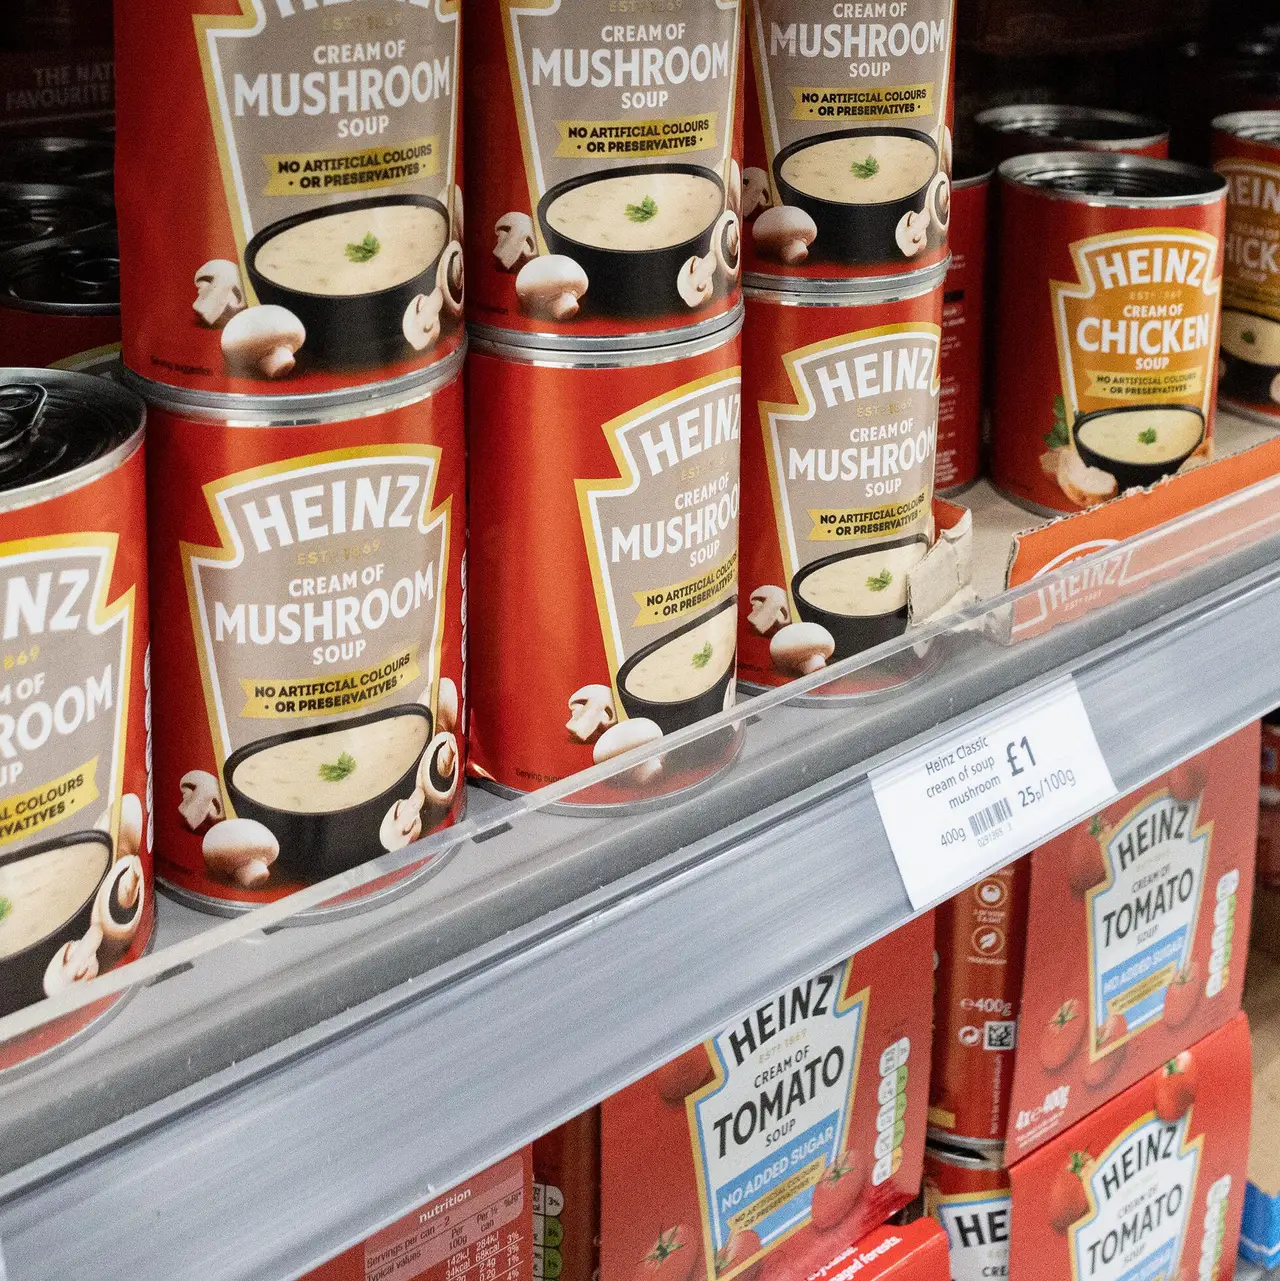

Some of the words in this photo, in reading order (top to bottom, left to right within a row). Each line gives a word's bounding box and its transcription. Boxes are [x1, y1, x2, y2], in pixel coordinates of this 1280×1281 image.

[833, 3, 885, 18] CREAM
[601, 24, 662, 43] CREAM
[770, 19, 946, 59] MUSHROOM
[312, 42, 382, 65] CREAM
[532, 41, 730, 88] MUSHROOM
[33, 63, 69, 86] THE
[849, 62, 891, 78] SOUP
[6, 83, 111, 110] FAVOURITE
[234, 56, 450, 118] MUSHROOM
[621, 90, 669, 110] SOUP
[337, 116, 390, 139] SOUP
[1096, 247, 1207, 291] HEINZ
[1123, 304, 1167, 318] CREAM
[1169, 304, 1183, 317] OF
[1077, 312, 1209, 357] CHICKEN
[1135, 356, 1170, 371] SOUP
[816, 348, 933, 408] HEINZ
[1096, 375, 1111, 385] NO
[1112, 375, 1161, 387] ARTIFICIAL
[1162, 372, 1197, 385] COLOURS
[1110, 386, 1123, 395] OR
[1124, 383, 1188, 396] PRESERVATIVES
[850, 423, 898, 443] CREAM
[675, 483, 717, 510] CREAM
[865, 478, 902, 498] SOUP
[242, 475, 419, 554] HEINZ
[611, 477, 739, 563] MUSHROO
[820, 514, 836, 524] NO
[839, 508, 895, 523] ARTIFICIAL
[836, 527, 851, 536] OR
[690, 540, 720, 568] SOUP
[289, 570, 357, 597] CREAM
[647, 594, 664, 606] NO
[666, 576, 715, 603] ARTIFICIAL
[1049, 556, 1128, 603] HEINZ
[215, 560, 434, 646] MUSHROOM
[663, 604, 678, 616] OR
[312, 639, 366, 666] SOUP
[255, 686, 275, 698] NO
[279, 677, 358, 697] ARTIFICIAL
[360, 653, 410, 684] COLOURS
[275, 700, 296, 713] OR
[298, 680, 397, 711] PRESERVATIVES
[925, 753, 954, 775] Heinz
[956, 736, 989, 760] Classic
[1006, 735, 1037, 777] £1
[926, 778, 957, 799] cream
[959, 767, 969, 782] of
[971, 755, 995, 777] soup
[1017, 767, 1076, 808] 25p/100g
[948, 775, 1001, 809] mushroom
[940, 826, 967, 848] 400g
[1117, 804, 1189, 872] HEINZ
[1102, 868, 1193, 948] TOMATO
[728, 973, 834, 1068] HEINZ
[712, 1045, 845, 1160] TOMATO
[744, 1156, 789, 1197] ADDED
[790, 1125, 834, 1169] SUGAR
[1101, 1125, 1177, 1200] HEINZ
[419, 1188, 471, 1223] nutrition
[449, 1235, 468, 1251] 100g
[481, 1221, 494, 1232] can
[451, 1225, 464, 1238] Per
[476, 1209, 489, 1224] Per
[1087, 1184, 1183, 1275] TOMATO
[367, 1243, 402, 1268] Servings
[404, 1236, 420, 1251] per
[420, 1226, 435, 1239] can
[475, 1242, 500, 1262] 68kcal
[507, 1244, 519, 1256] 3%
[476, 1231, 499, 1252] 284kJ
[507, 1232, 519, 1244] 3%
[860, 1236, 903, 1264] forests.
[446, 1258, 470, 1280] 34kcal
[447, 1249, 469, 1268] 142kJ
[479, 1258, 496, 1270] 2.4g
[507, 1255, 519, 1267] 1%
[982, 1266, 1008, 1277] CRE
